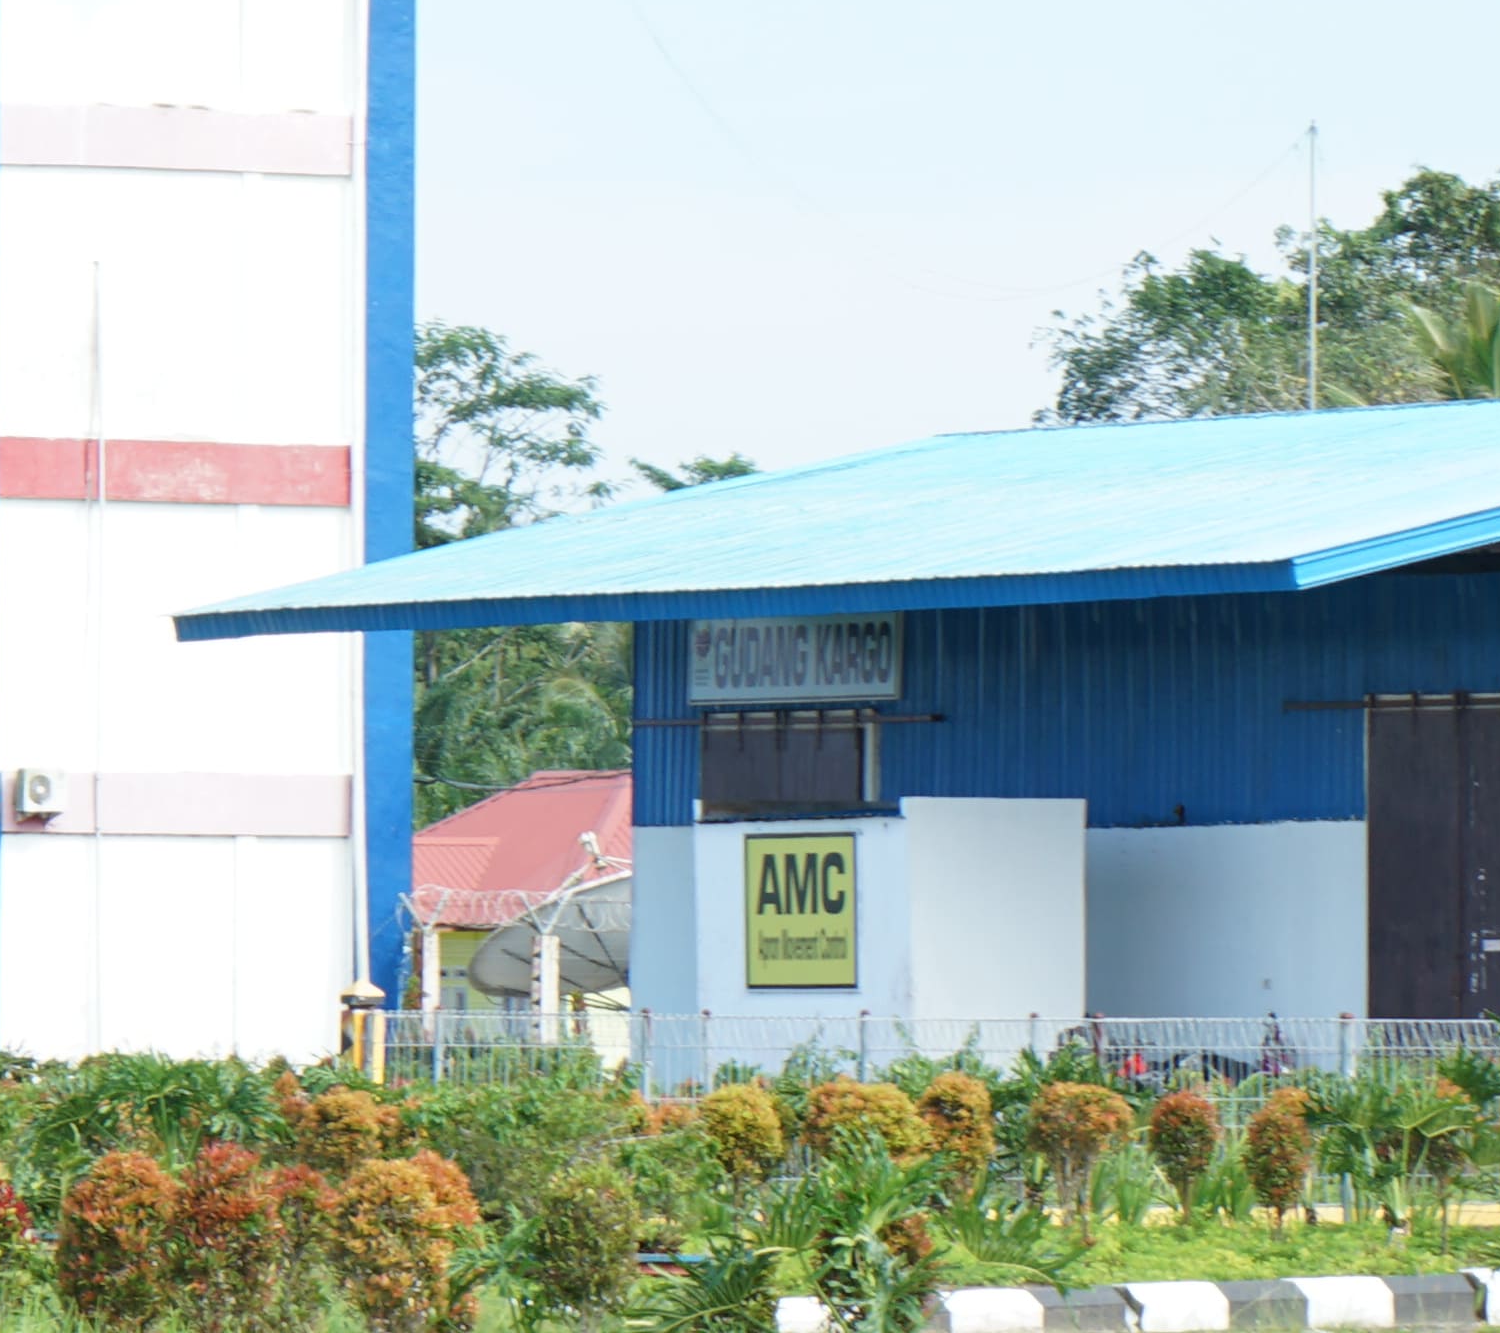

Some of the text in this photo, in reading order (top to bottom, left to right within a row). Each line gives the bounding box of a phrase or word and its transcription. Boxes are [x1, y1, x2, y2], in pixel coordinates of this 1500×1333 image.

[714, 621, 892, 688] GUDANG KARGO
[757, 852, 846, 915] AMC
